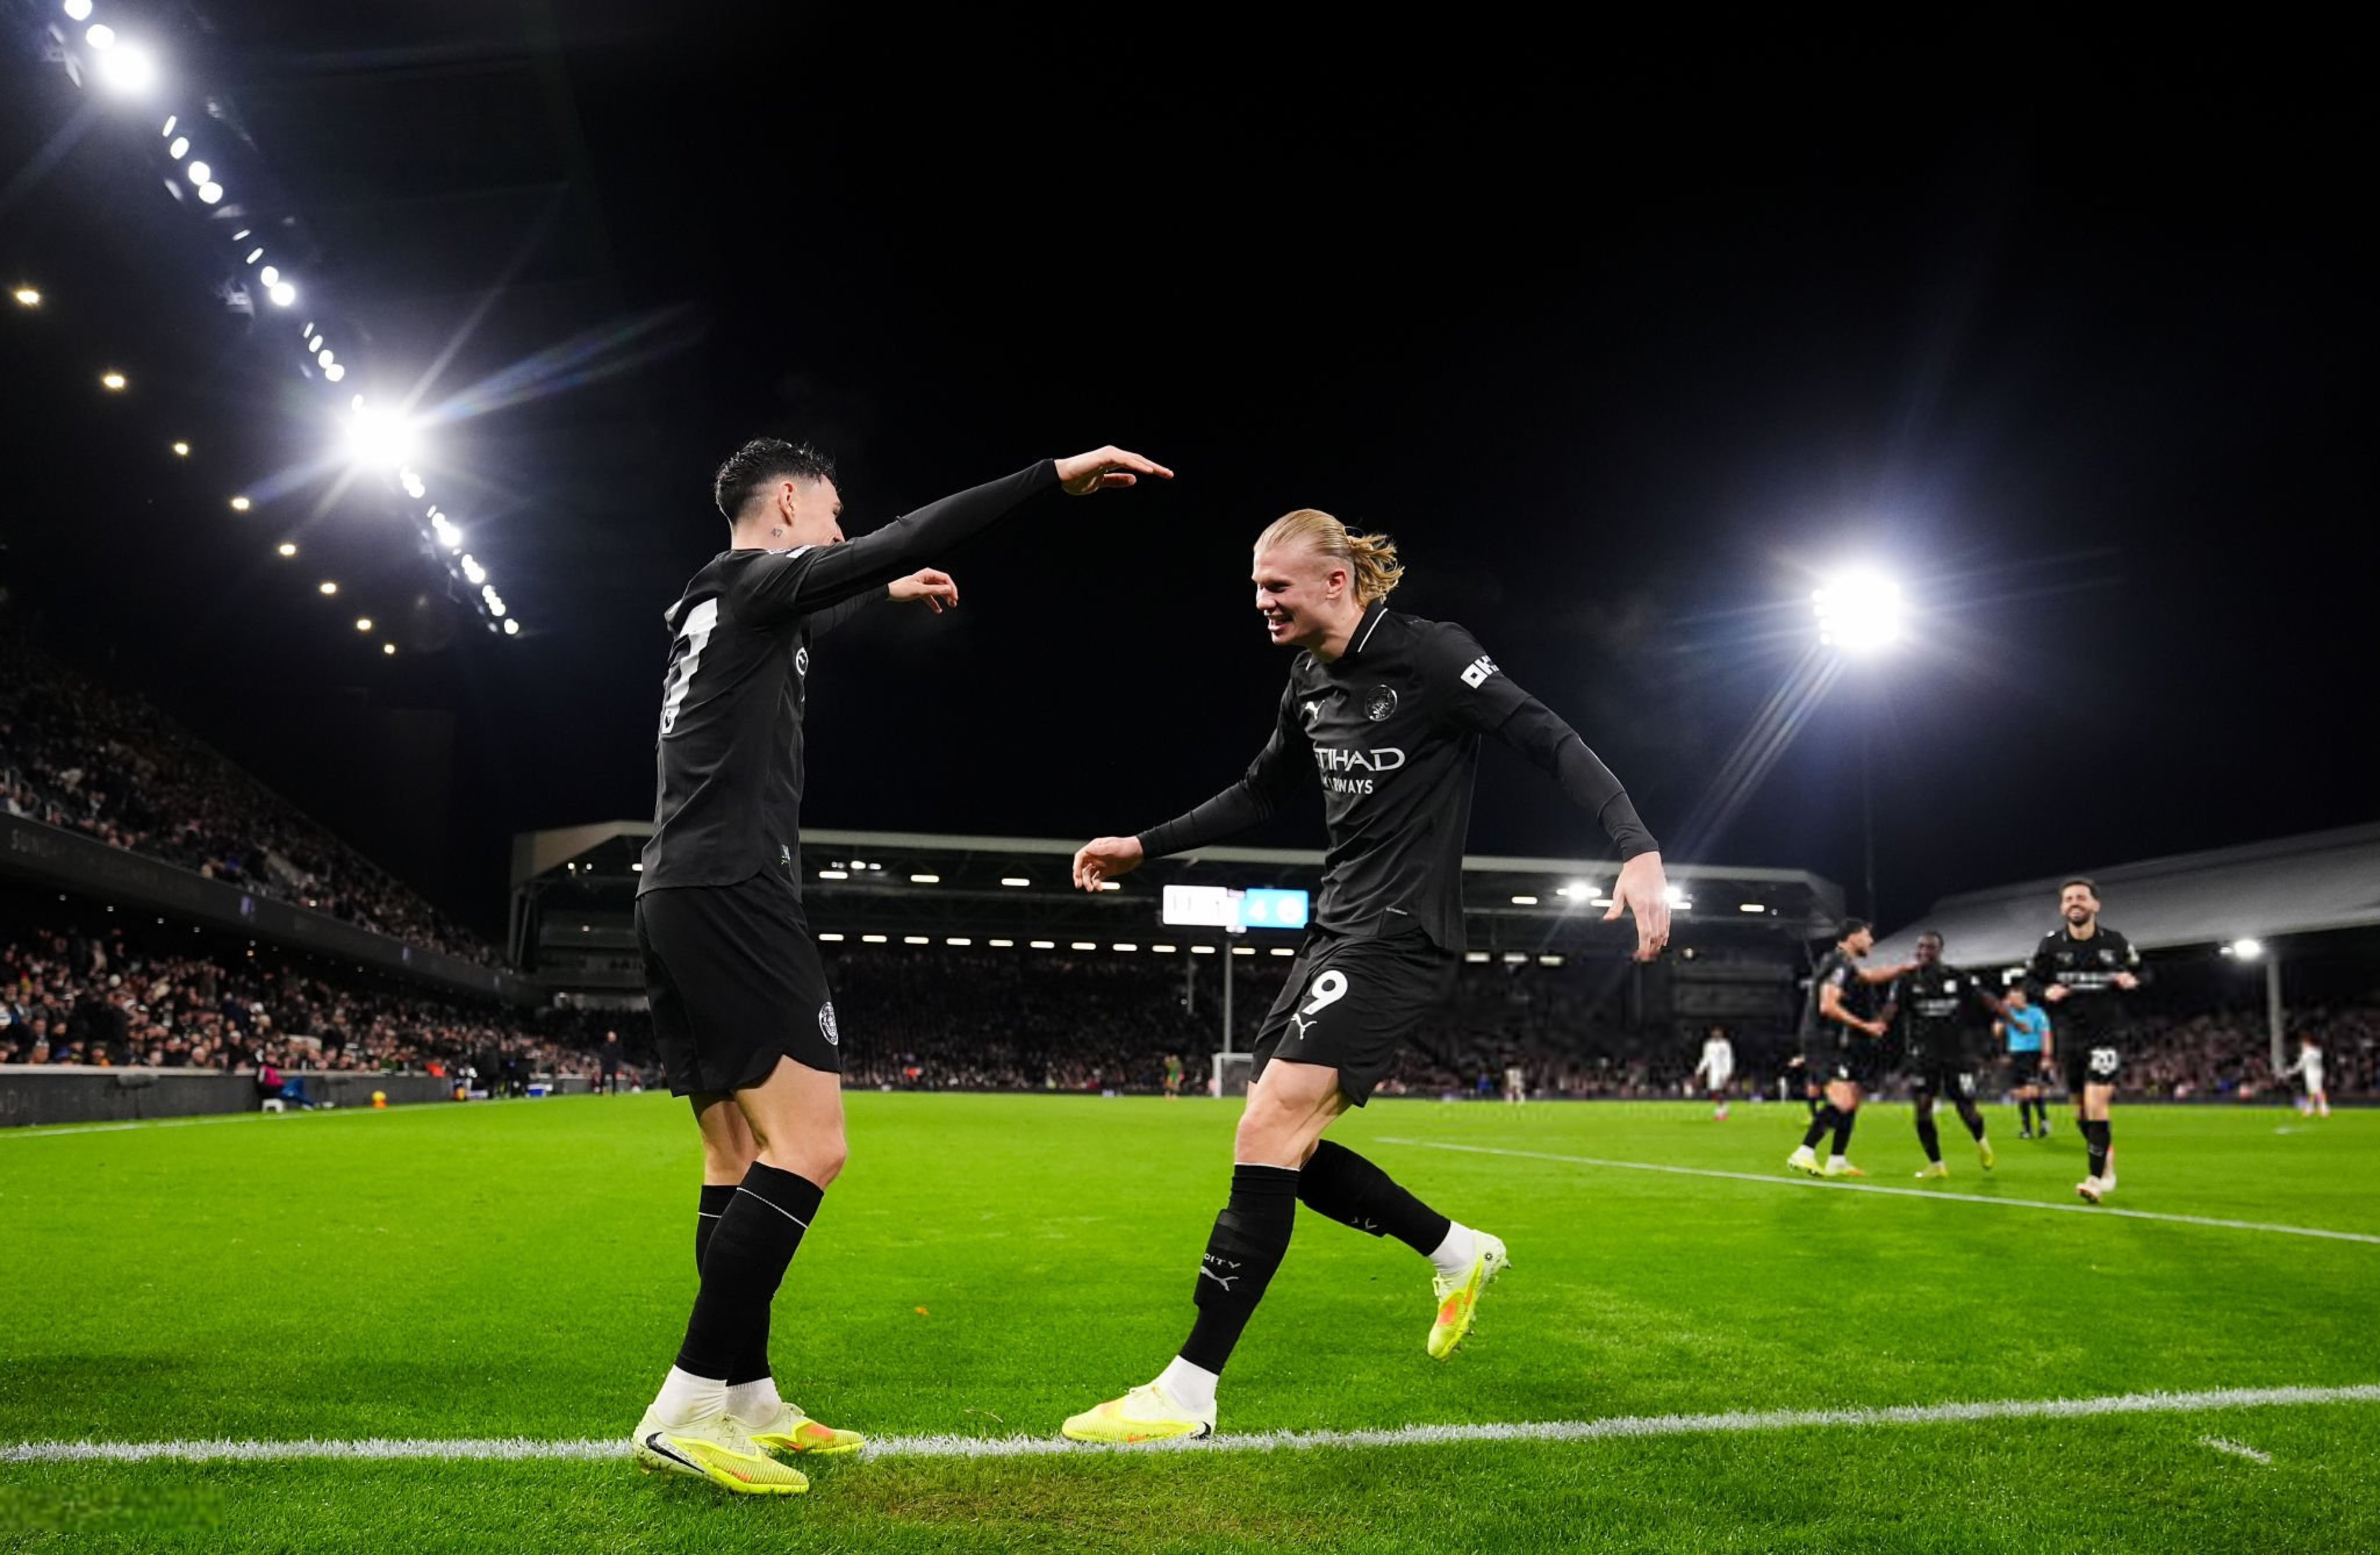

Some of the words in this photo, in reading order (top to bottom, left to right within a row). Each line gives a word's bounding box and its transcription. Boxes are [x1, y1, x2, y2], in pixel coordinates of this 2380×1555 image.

[771, 528, 783, 538] 47
[1313, 746, 1406, 772] TIHAD
[1302, 970, 1348, 1015] 9
